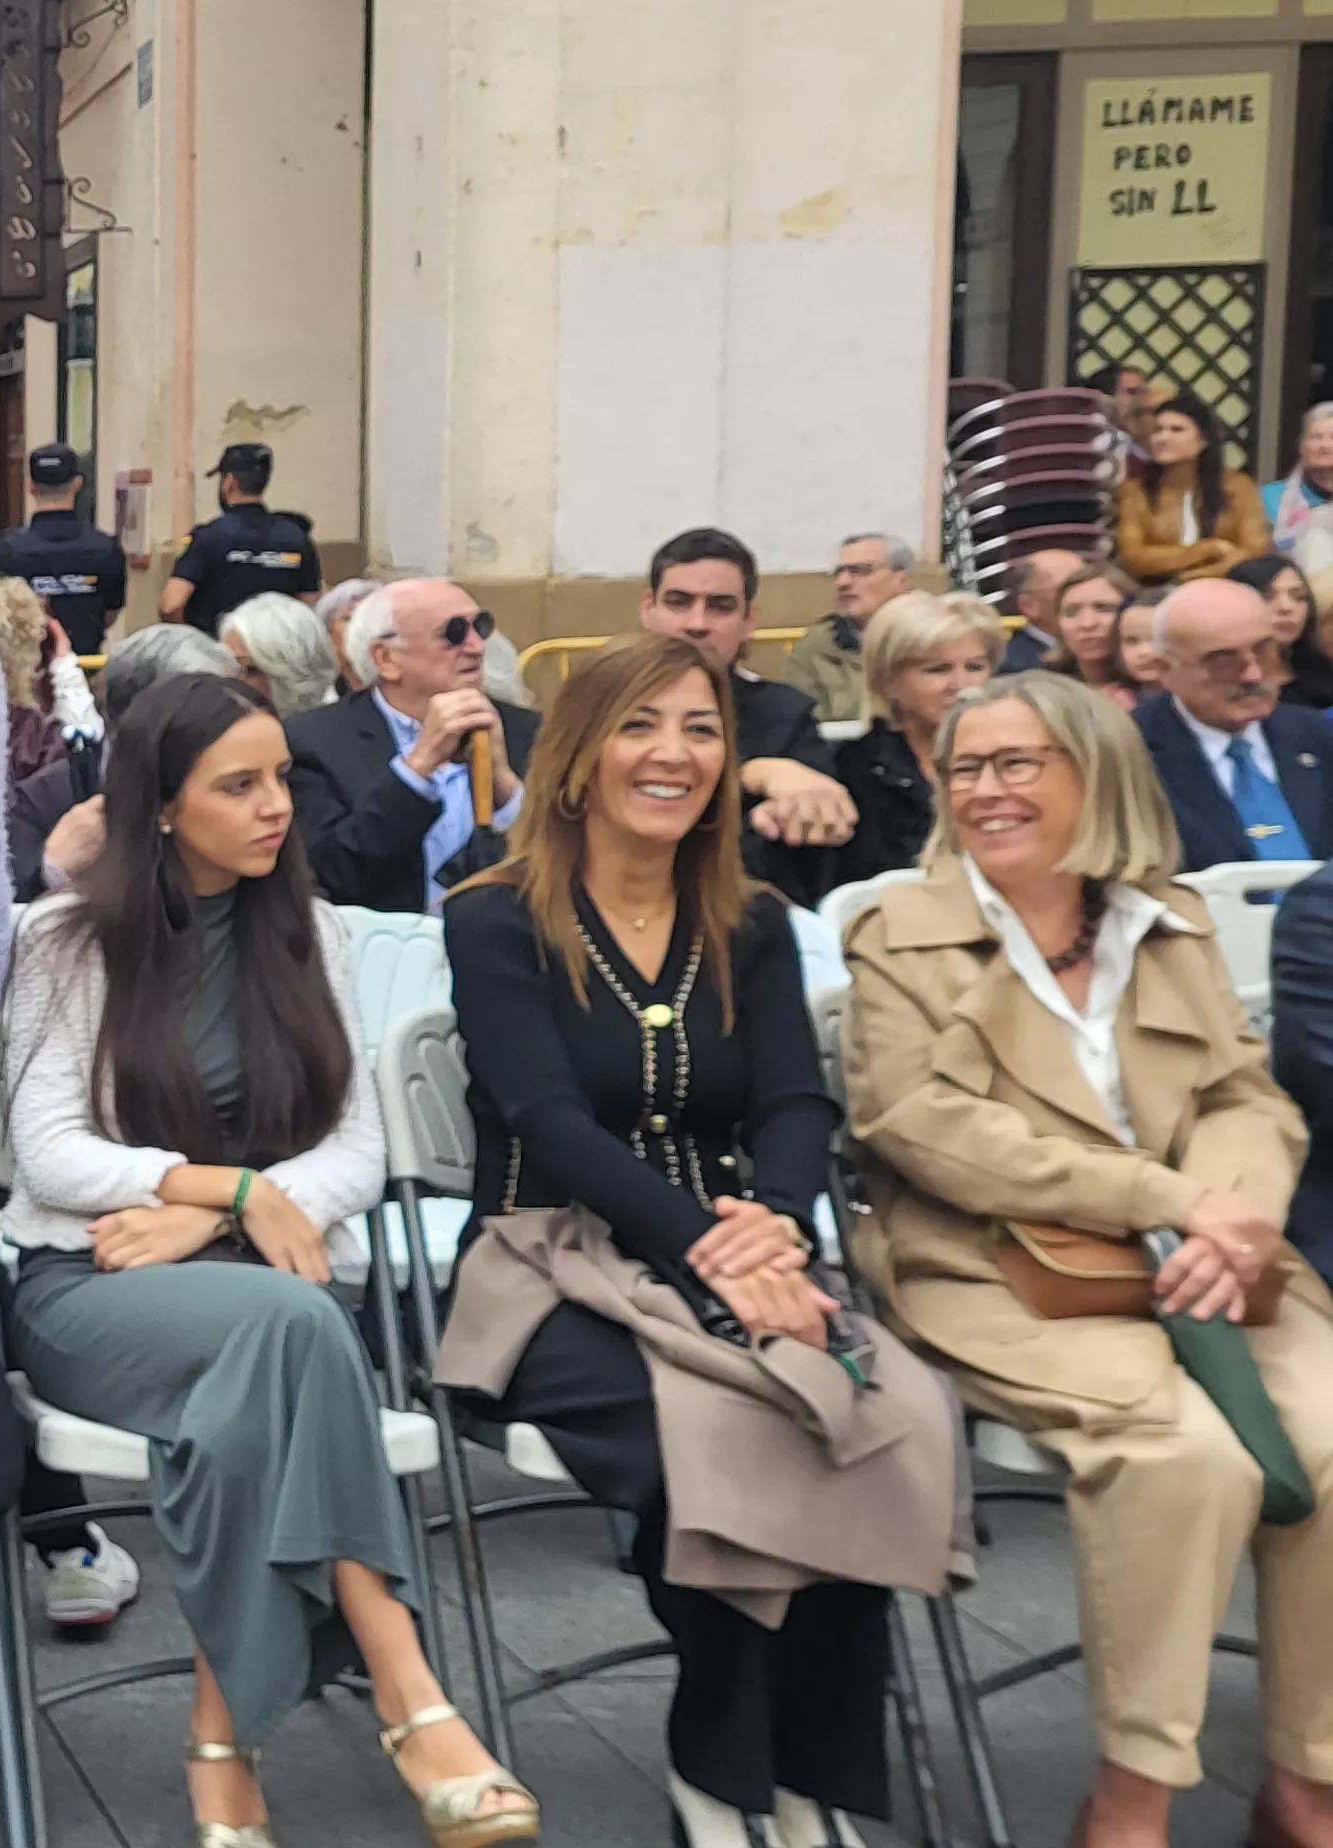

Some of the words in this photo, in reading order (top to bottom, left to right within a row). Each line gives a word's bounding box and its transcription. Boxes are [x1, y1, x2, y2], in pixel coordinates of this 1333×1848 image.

[1102, 87, 1256, 129] LLÁMAME
[1113, 142, 1192, 171] PERO
[1109, 186, 1157, 217] SIN
[1171, 178, 1217, 217] LL
